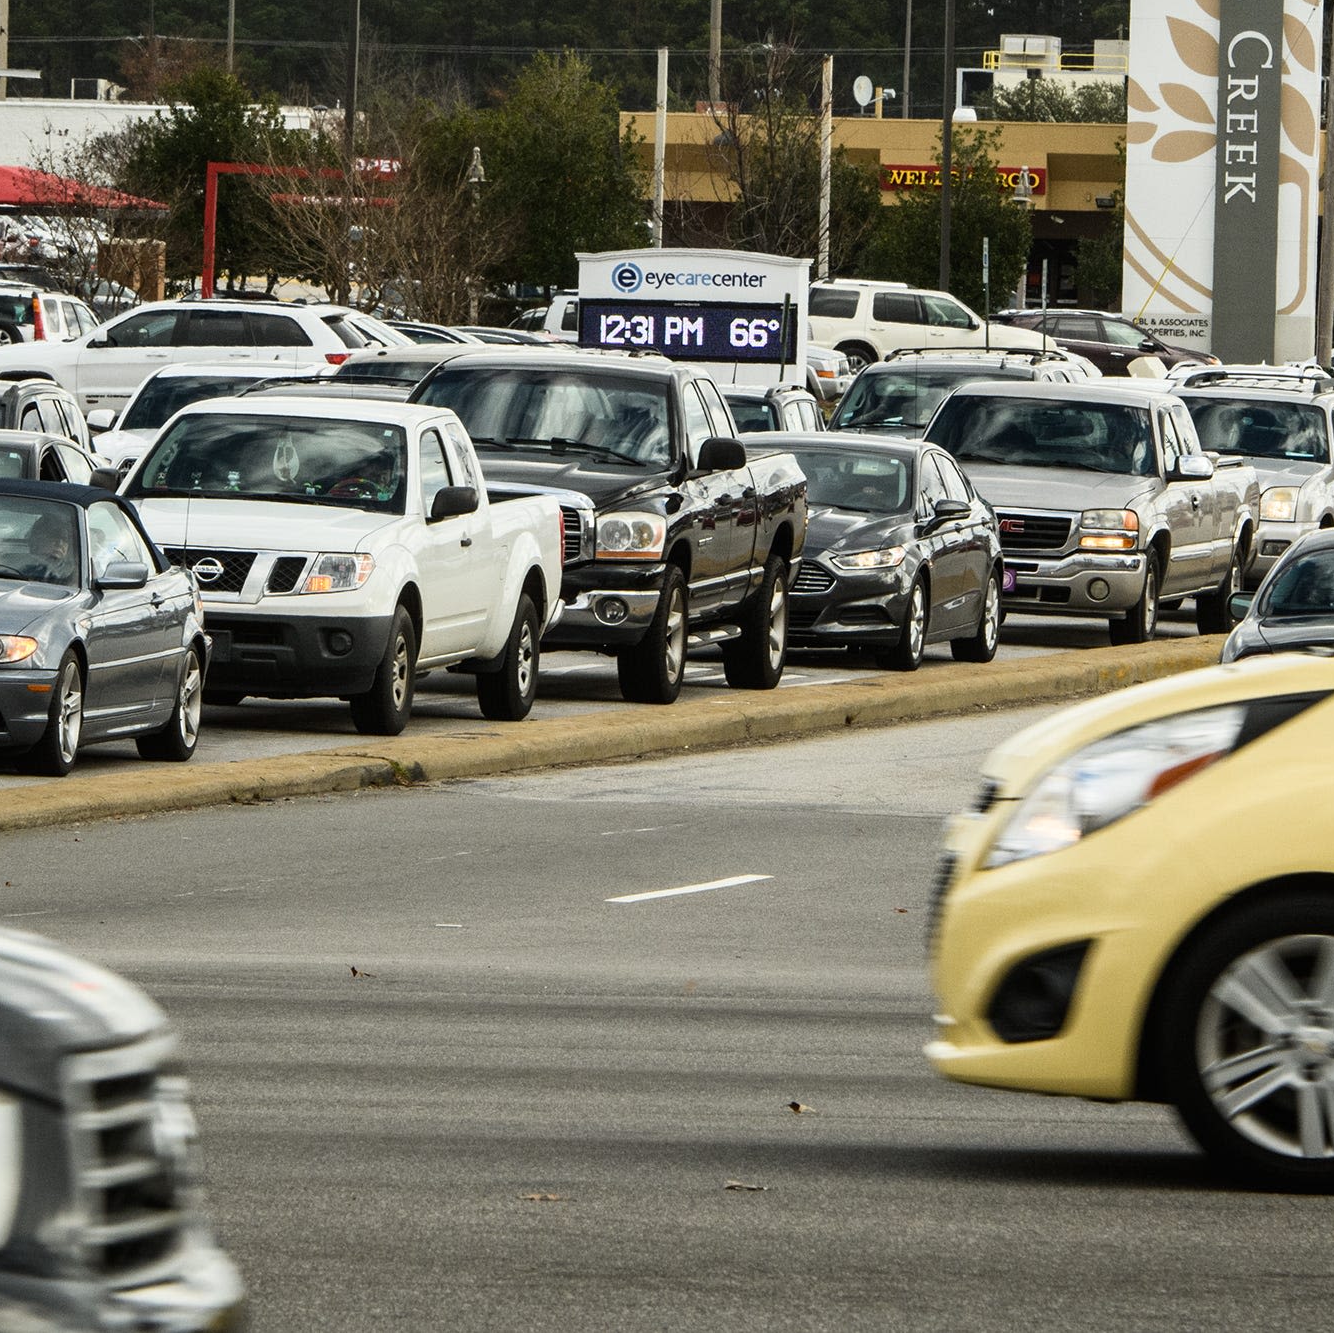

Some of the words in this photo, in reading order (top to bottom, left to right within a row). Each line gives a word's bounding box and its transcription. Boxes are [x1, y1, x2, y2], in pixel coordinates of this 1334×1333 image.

[645, 271, 767, 289] eyecarecenter
[1158, 319, 1209, 327] ASSOCIATES
[600, 315, 654, 345] 12:31
[664, 317, 704, 346] PM
[729, 318, 780, 348] 66°
[1189, 329, 1207, 337] INC.
